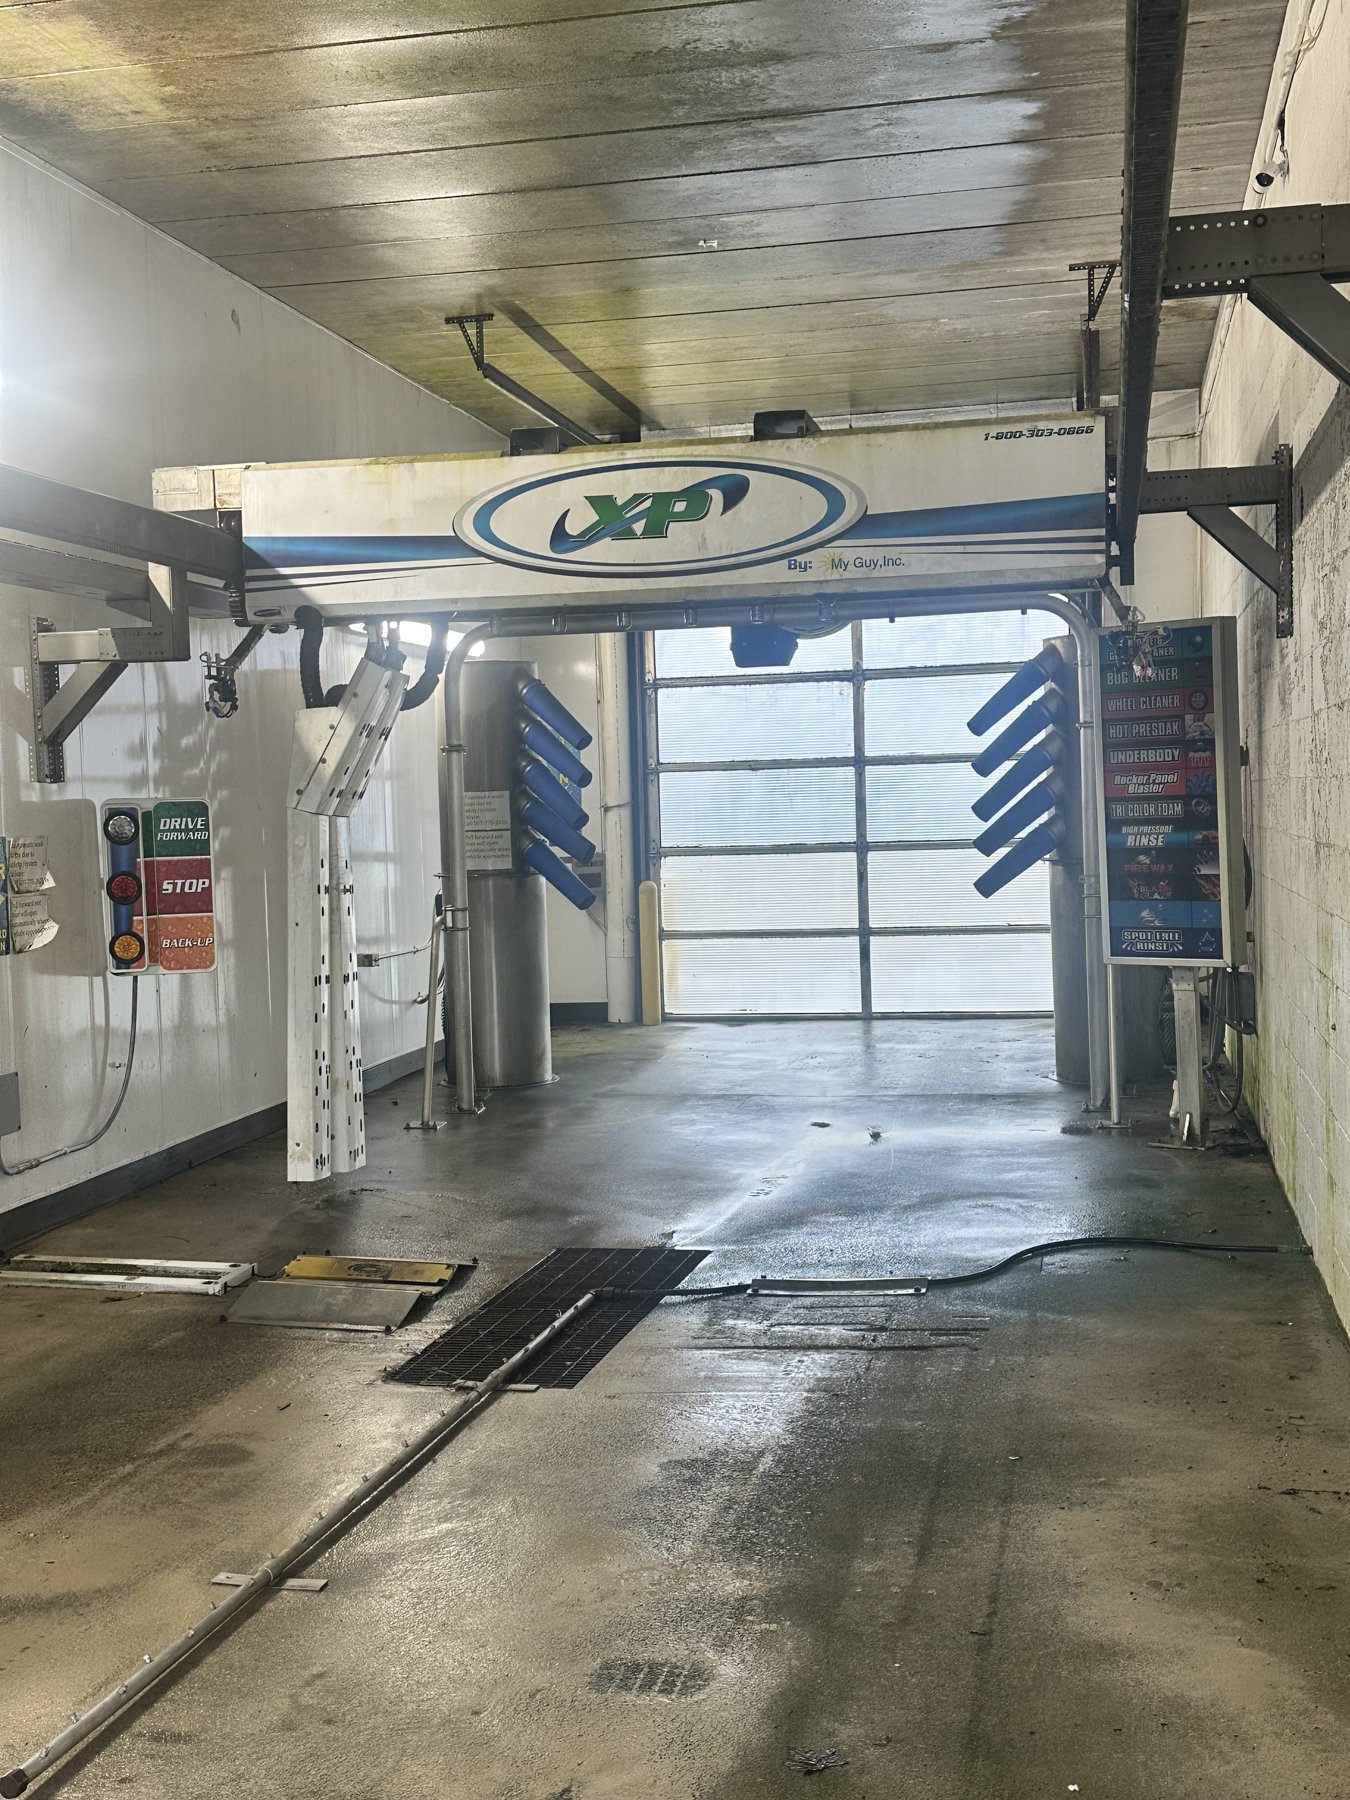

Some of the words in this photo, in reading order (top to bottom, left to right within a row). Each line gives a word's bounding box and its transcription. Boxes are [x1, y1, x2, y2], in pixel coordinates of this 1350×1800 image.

[570, 489, 713, 541] XP
[787, 558, 813, 573] By:
[831, 558, 850, 571] My
[1107, 671, 1128, 686] BUG
[1108, 697, 1137, 712] WHEEL
[1140, 694, 1180, 710] CLEANER
[1109, 724, 1129, 739] HOT
[1109, 748, 1181, 764] UNDERBODY
[1114, 773, 1148, 785] Rocker
[1149, 771, 1178, 783] Panel
[1127, 783, 1165, 794] Blaster
[1112, 804, 1125, 817] TRI
[1128, 803, 1155, 816] COLOR
[1158, 802, 1182, 816] FOAM
[159, 817, 207, 830] DRIVE
[1139, 824, 1174, 834] PRESSURE
[157, 830, 209, 841] FORWARD
[1127, 834, 1165, 847] RINSE
[162, 878, 210, 894] STOP
[162, 937, 214, 948] BACK-UP
[1124, 931, 1153, 941] SPOT
[1155, 930, 1181, 941] FREE
[1136, 941, 1169, 951] RINSE
